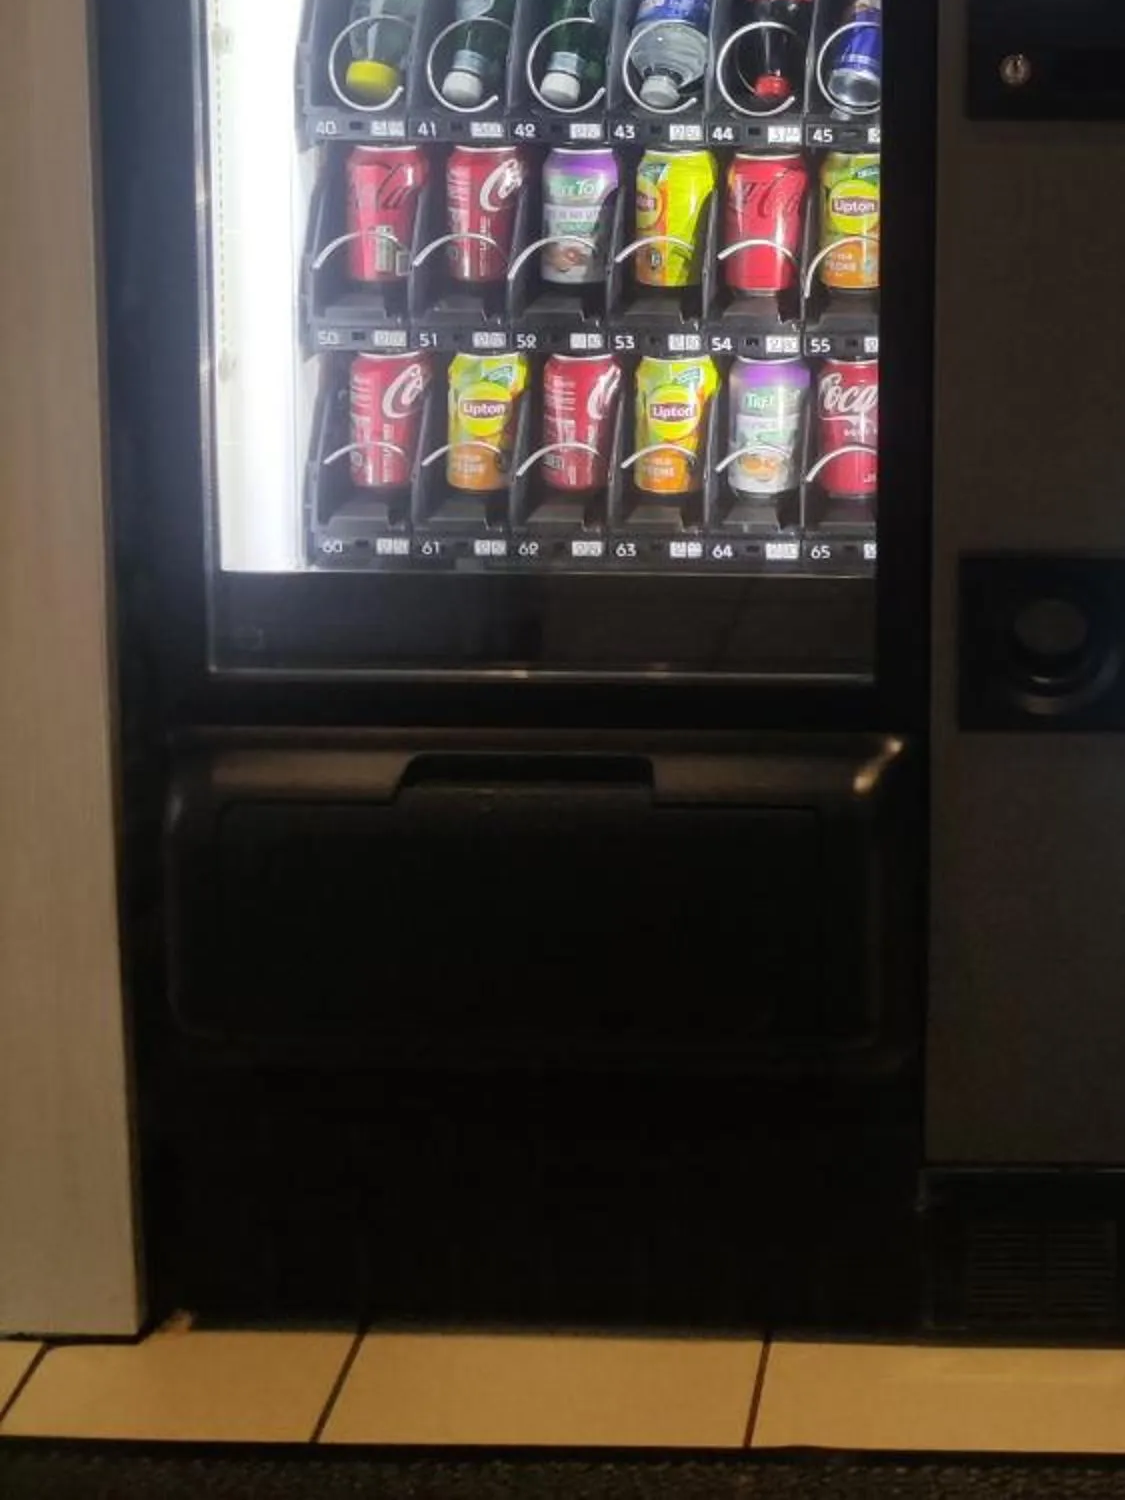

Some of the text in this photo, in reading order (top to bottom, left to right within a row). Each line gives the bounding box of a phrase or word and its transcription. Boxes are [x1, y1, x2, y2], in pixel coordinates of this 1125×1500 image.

[316, 121, 337, 135] 40
[417, 121, 437, 136] 41
[514, 123, 535, 138] 42
[613, 126, 635, 140] 43
[711, 126, 734, 141] 44
[812, 128, 834, 143] 45
[833, 200, 875, 214] Lipton
[318, 332, 340, 347] 50
[419, 332, 438, 347] 51
[516, 334, 538, 350] 52
[614, 335, 635, 350] 53
[711, 336, 733, 351] 54
[810, 337, 831, 352] 55
[462, 402, 506, 416] Lipton
[652, 405, 694, 419] Lipton
[322, 540, 343, 554] 60
[421, 541, 440, 555] 61
[518, 542, 540, 556] 62
[615, 543, 636, 558] 63
[711, 544, 733, 559] 64
[810, 545, 831, 560] 65
